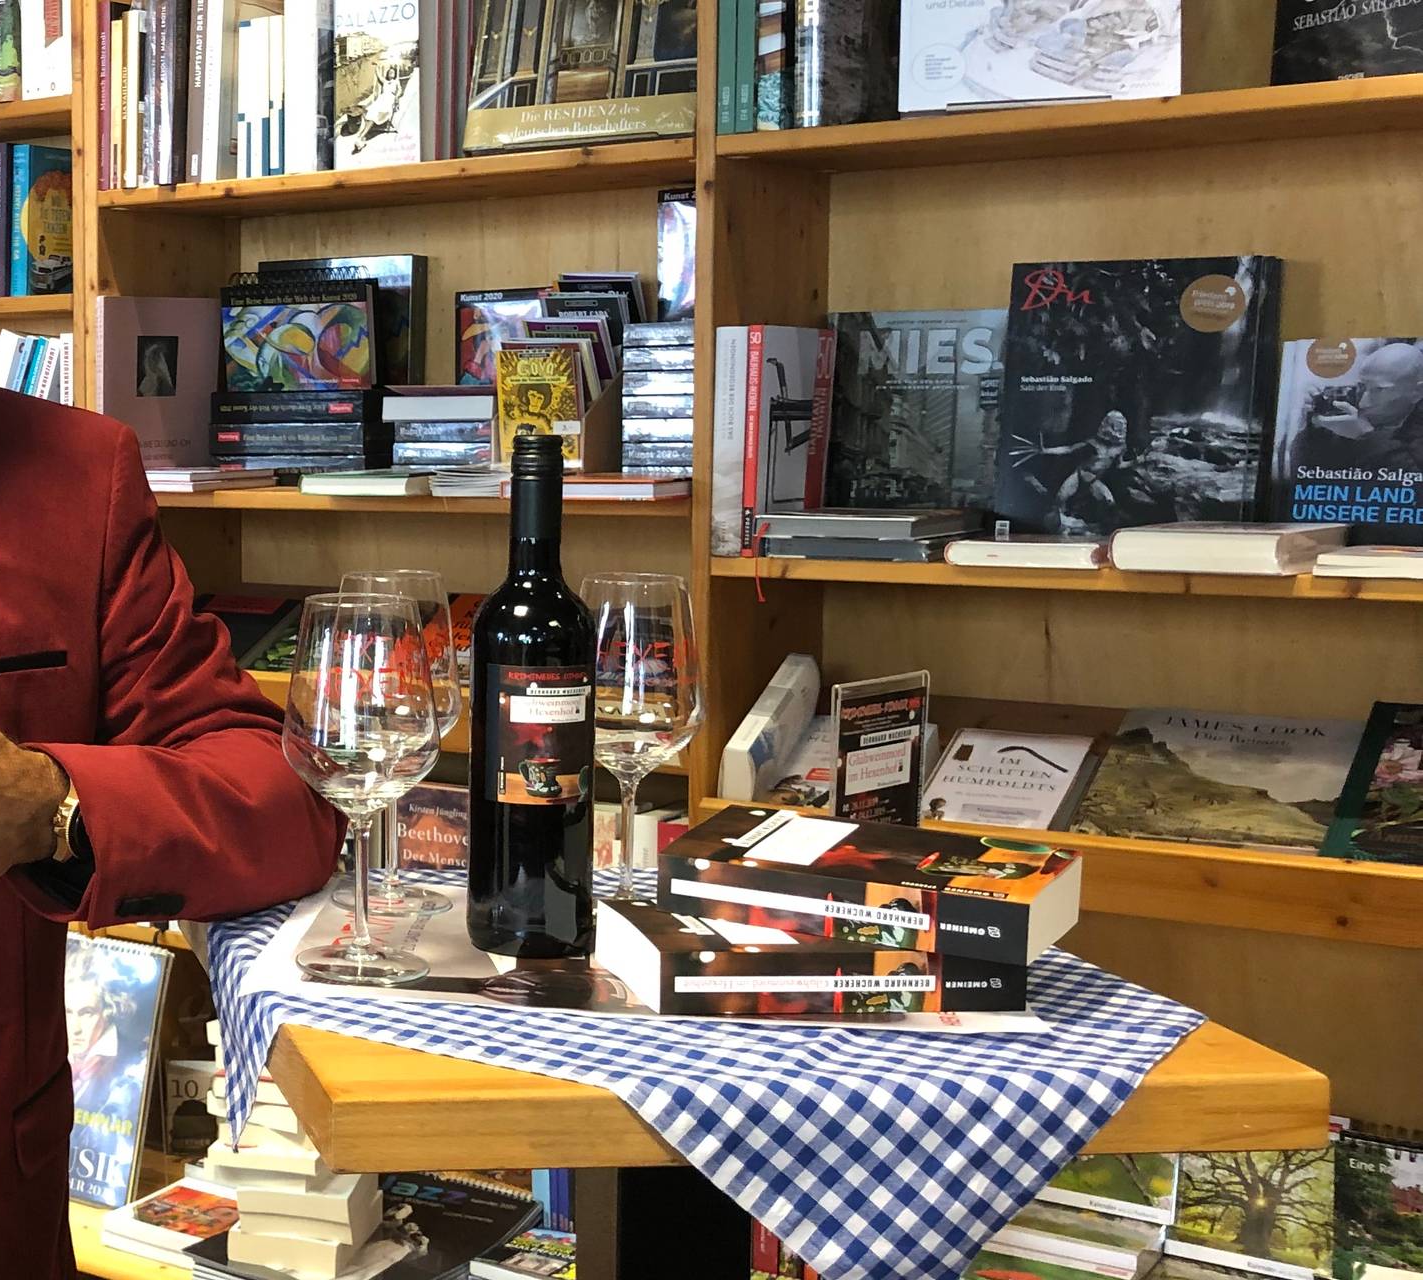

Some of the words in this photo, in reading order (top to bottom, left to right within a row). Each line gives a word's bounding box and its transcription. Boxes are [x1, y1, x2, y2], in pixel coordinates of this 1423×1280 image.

[334, 1, 417, 29] PALAZZO
[194, 33, 203, 89] HAUPTSTADT
[520, 111, 541, 123] Die
[543, 104, 618, 121] RESIDENZ
[618, 102, 641, 115] des
[572, 118, 648, 134] Botschafters
[663, 190, 688, 201] Kunst
[459, 292, 482, 302] Kunst
[482, 292, 504, 301] 2020
[749, 331, 762, 345] 50
[1020, 375, 1060, 384] Sebastião
[1060, 376, 1093, 386] Salgado
[1037, 384, 1048, 392] der
[1049, 384, 1067, 392] Erde
[1296, 465, 1373, 481] Sebastião
[1293, 483, 1352, 502] MEIN
[1291, 503, 1380, 524] UNSERE
[1165, 715, 1248, 733] JAMES
[1251, 724, 1326, 738] COOK
[888, 729, 912, 741] WUCHERER
[1000, 756, 1022, 766] IM
[860, 765, 898, 781] Hexenhof
[958, 764, 1053, 780] SCHATTEN
[943, 775, 1057, 792] HUMBOLDTS
[408, 802, 435, 815] Kirsten
[435, 806, 467, 820] Jüngling
[402, 848, 427, 862] Der
[824, 904, 873, 919] WUCHERER
[876, 910, 925, 926] BERNHARD
[939, 922, 987, 937] GMEINER
[833, 979, 881, 989] WUCHERER
[884, 978, 930, 988] BERNHARD
[945, 981, 988, 989] GMEINER
[171, 1079, 199, 1099] 10
[1347, 1157, 1376, 1173] Eine
